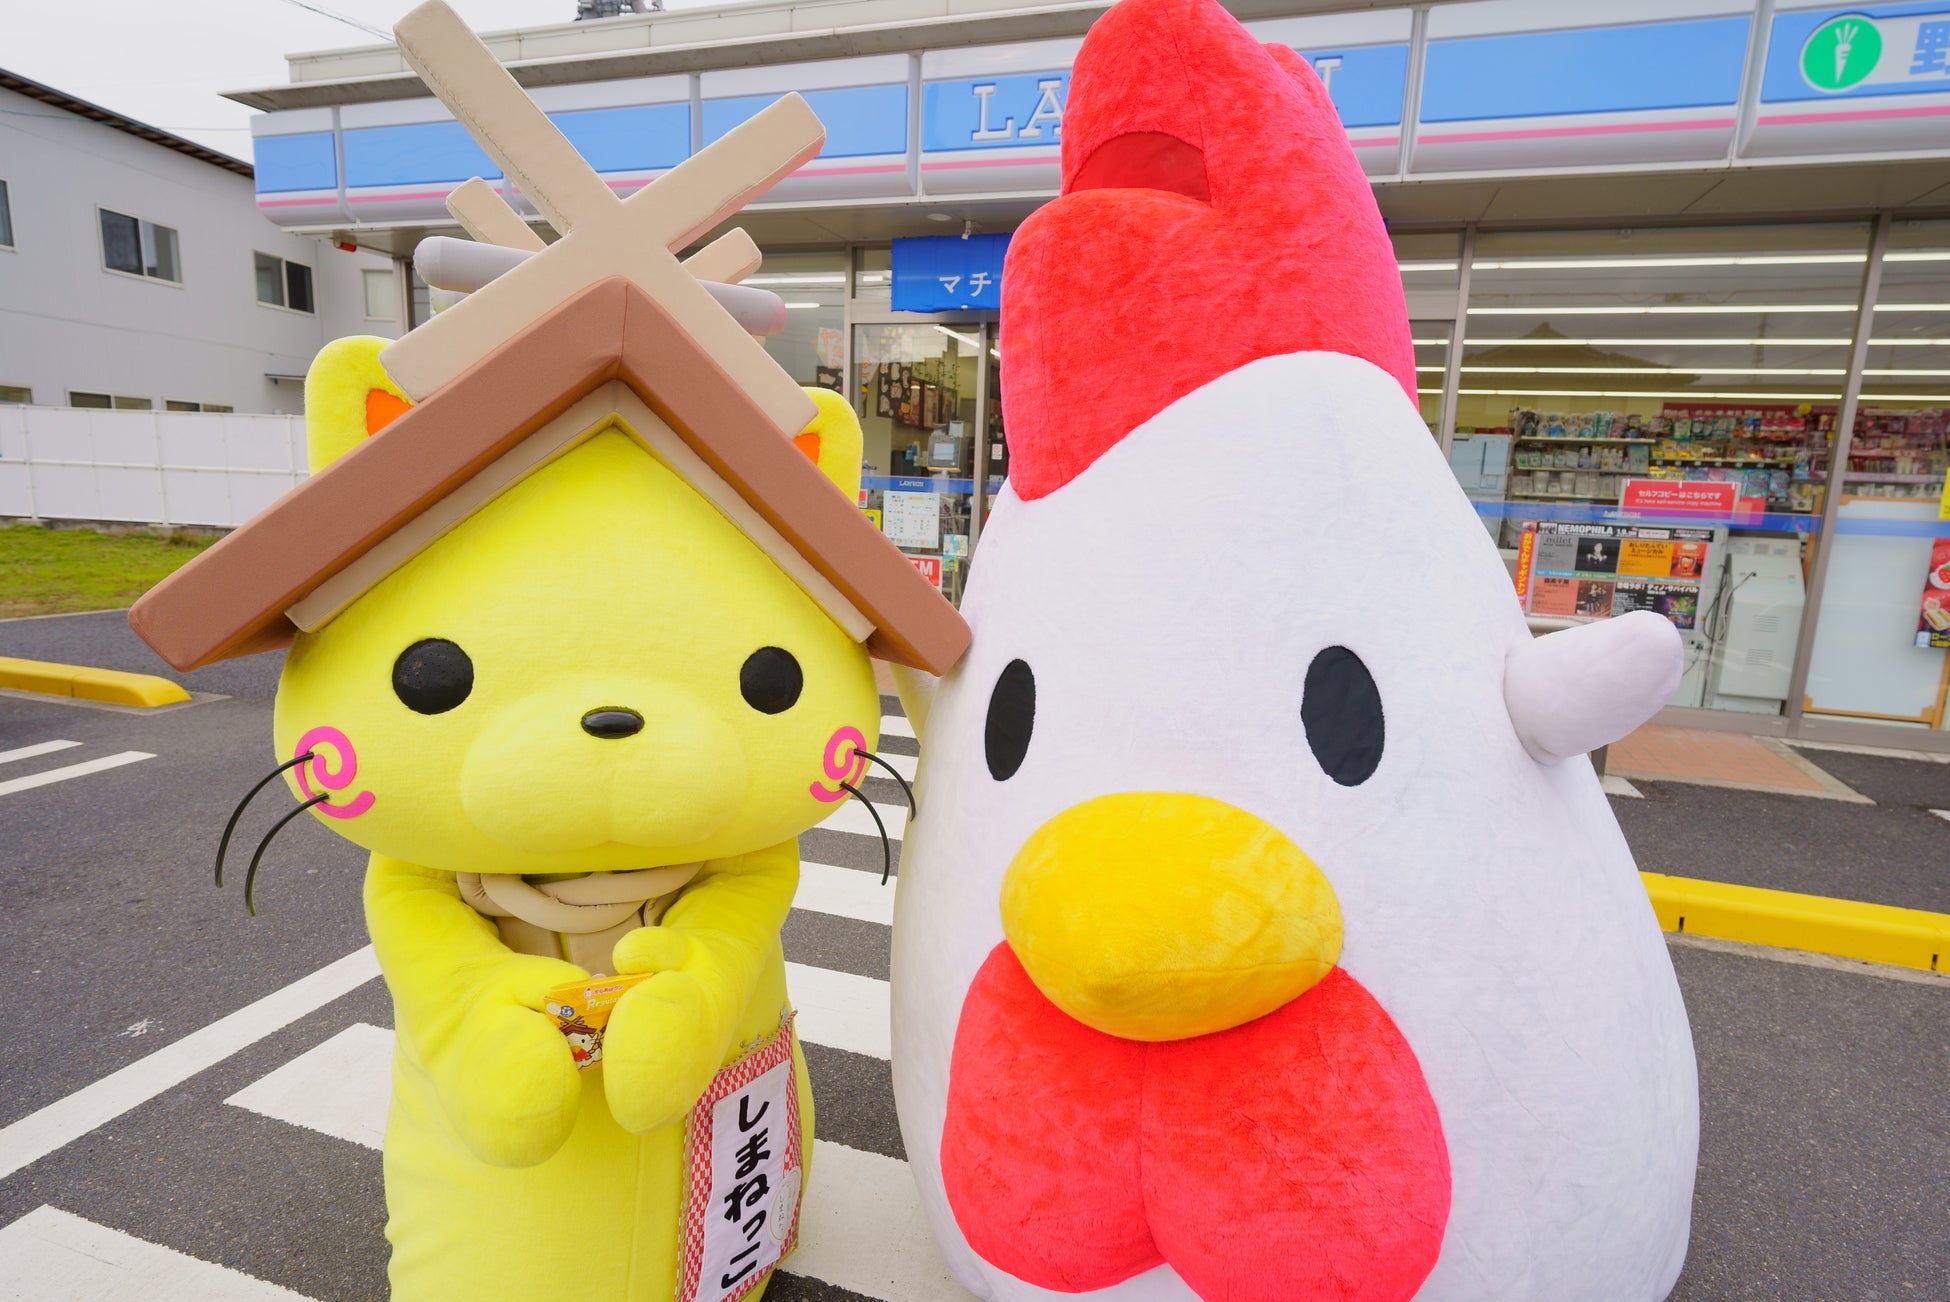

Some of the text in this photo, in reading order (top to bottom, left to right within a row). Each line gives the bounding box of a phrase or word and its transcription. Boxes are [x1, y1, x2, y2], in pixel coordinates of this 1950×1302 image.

[1558, 524, 1614, 535] NEMOPHILA
[721, 1094, 770, 1290] しまねっこ
